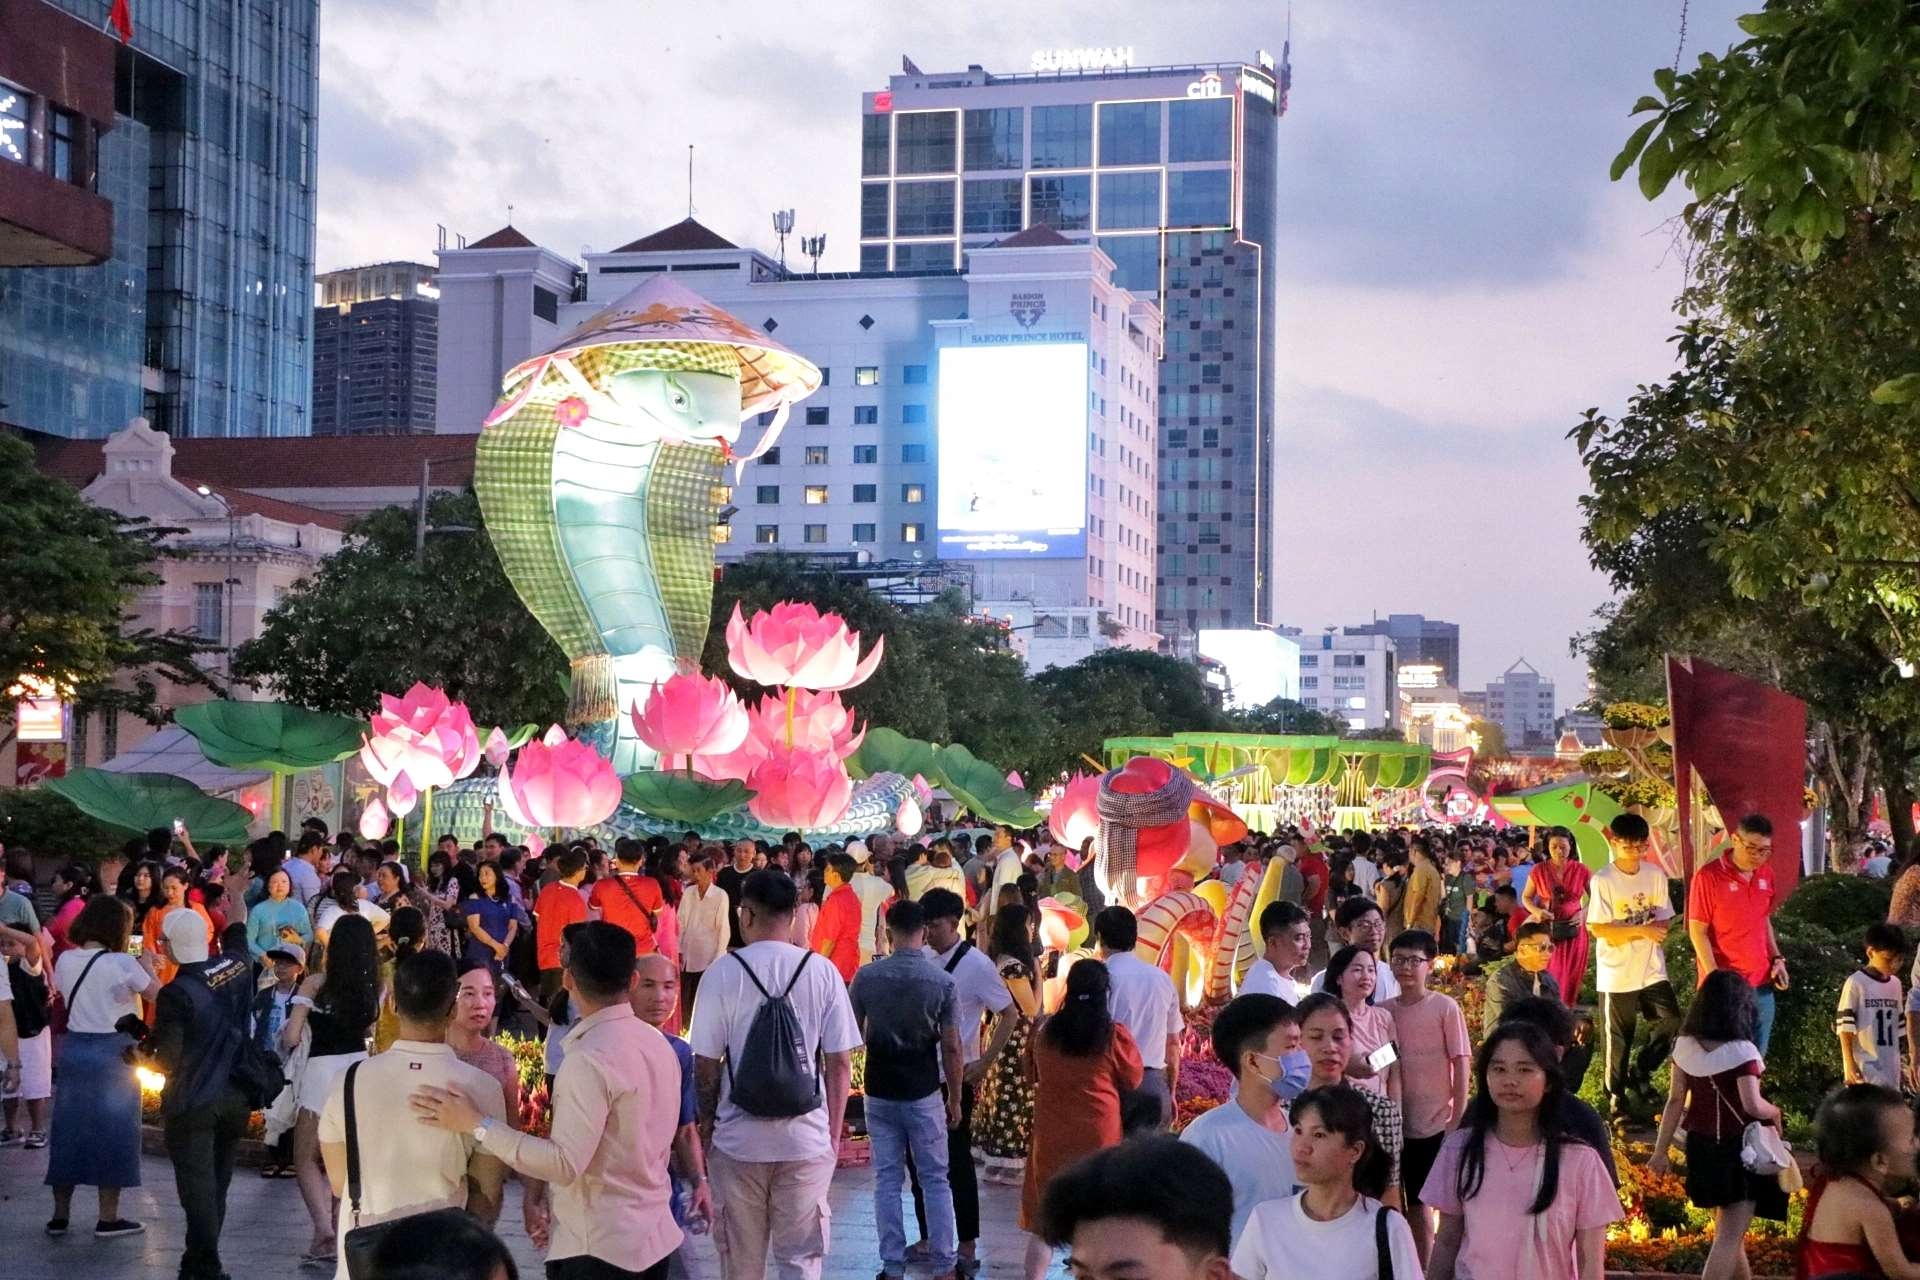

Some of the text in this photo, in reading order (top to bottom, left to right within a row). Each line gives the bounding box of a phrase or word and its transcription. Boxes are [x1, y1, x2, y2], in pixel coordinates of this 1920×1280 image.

[1031, 46, 1133, 71] SUNWAH
[1187, 74, 1222, 97] citi
[971, 331, 1085, 344] SAIGON PRINCE HOTEL
